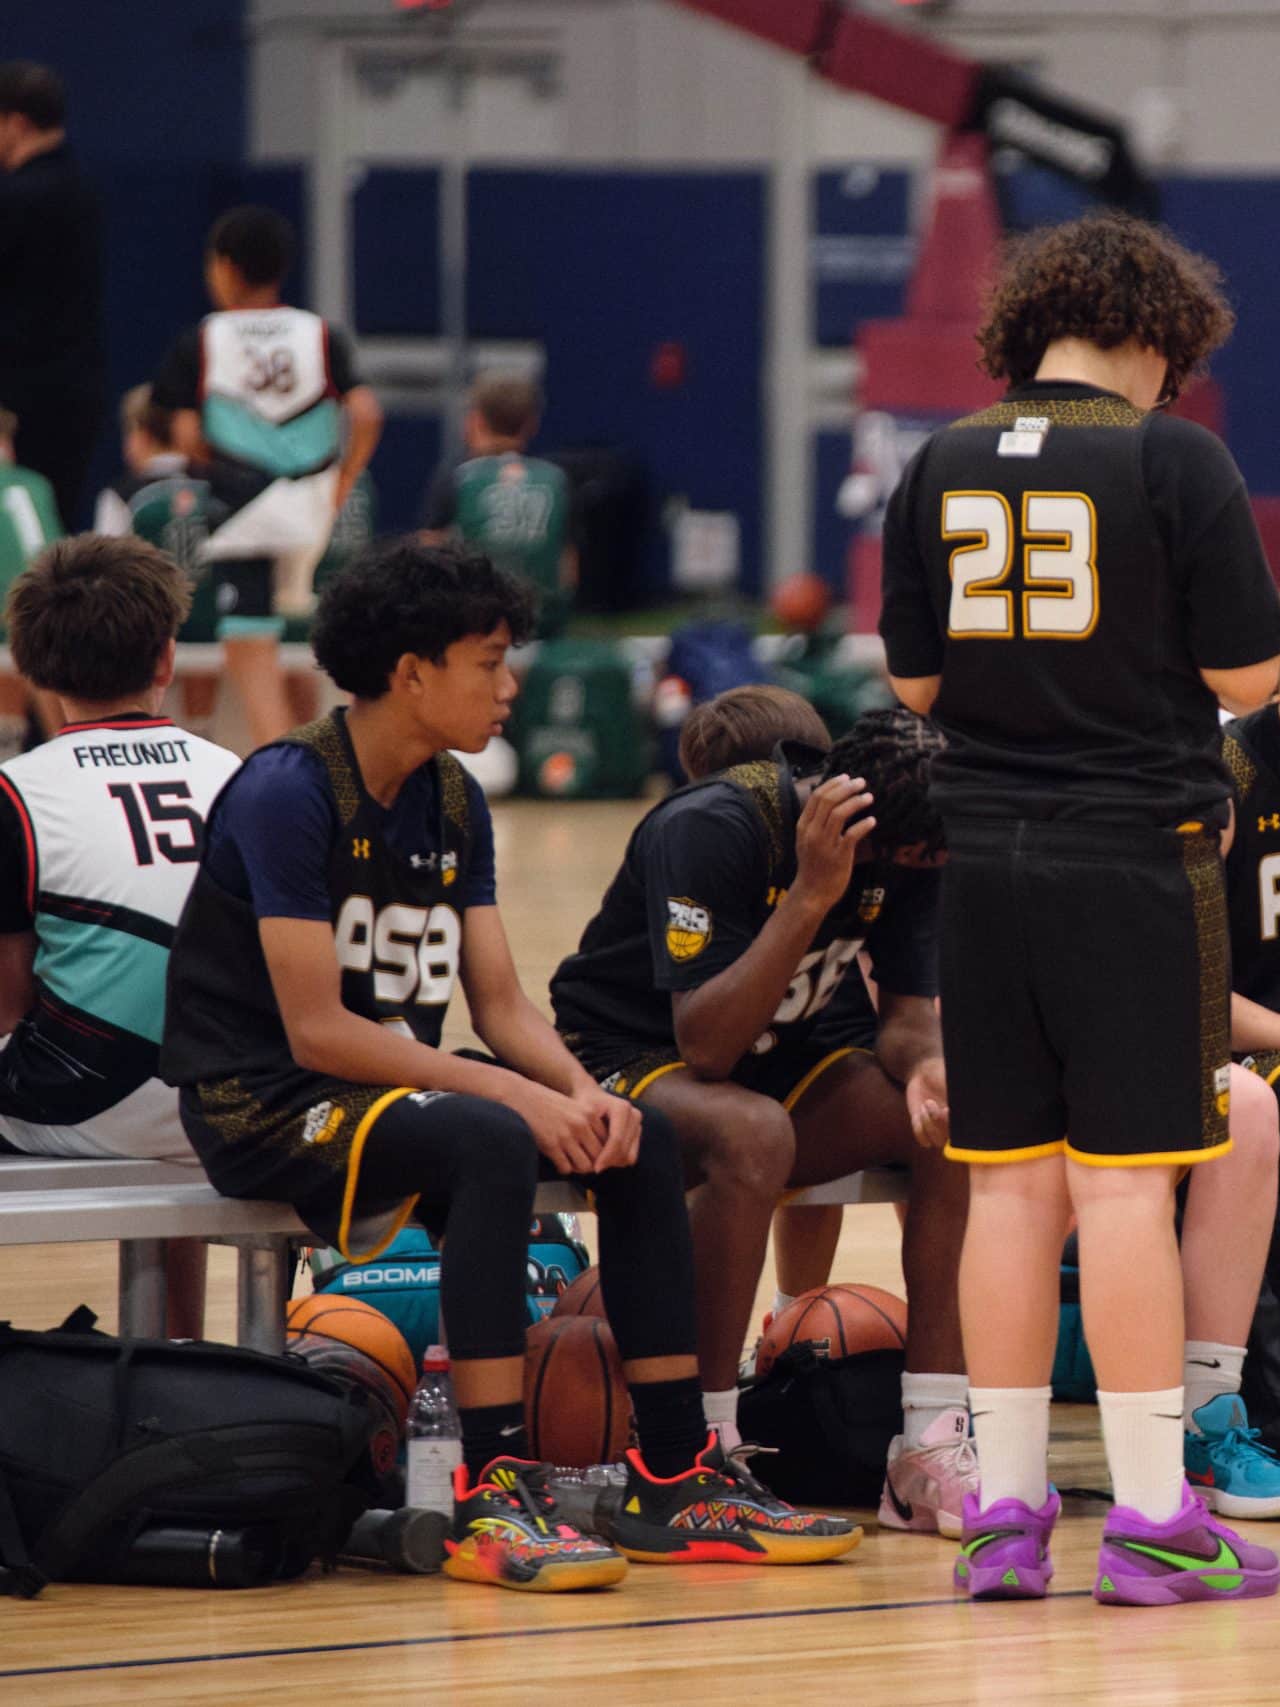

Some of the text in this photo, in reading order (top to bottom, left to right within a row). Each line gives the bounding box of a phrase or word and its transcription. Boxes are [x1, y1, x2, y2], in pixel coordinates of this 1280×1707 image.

[941, 489, 1100, 640] 23
[73, 740, 193, 769] FREUNDT
[106, 780, 207, 867] 15
[335, 893, 462, 1006] PSB
